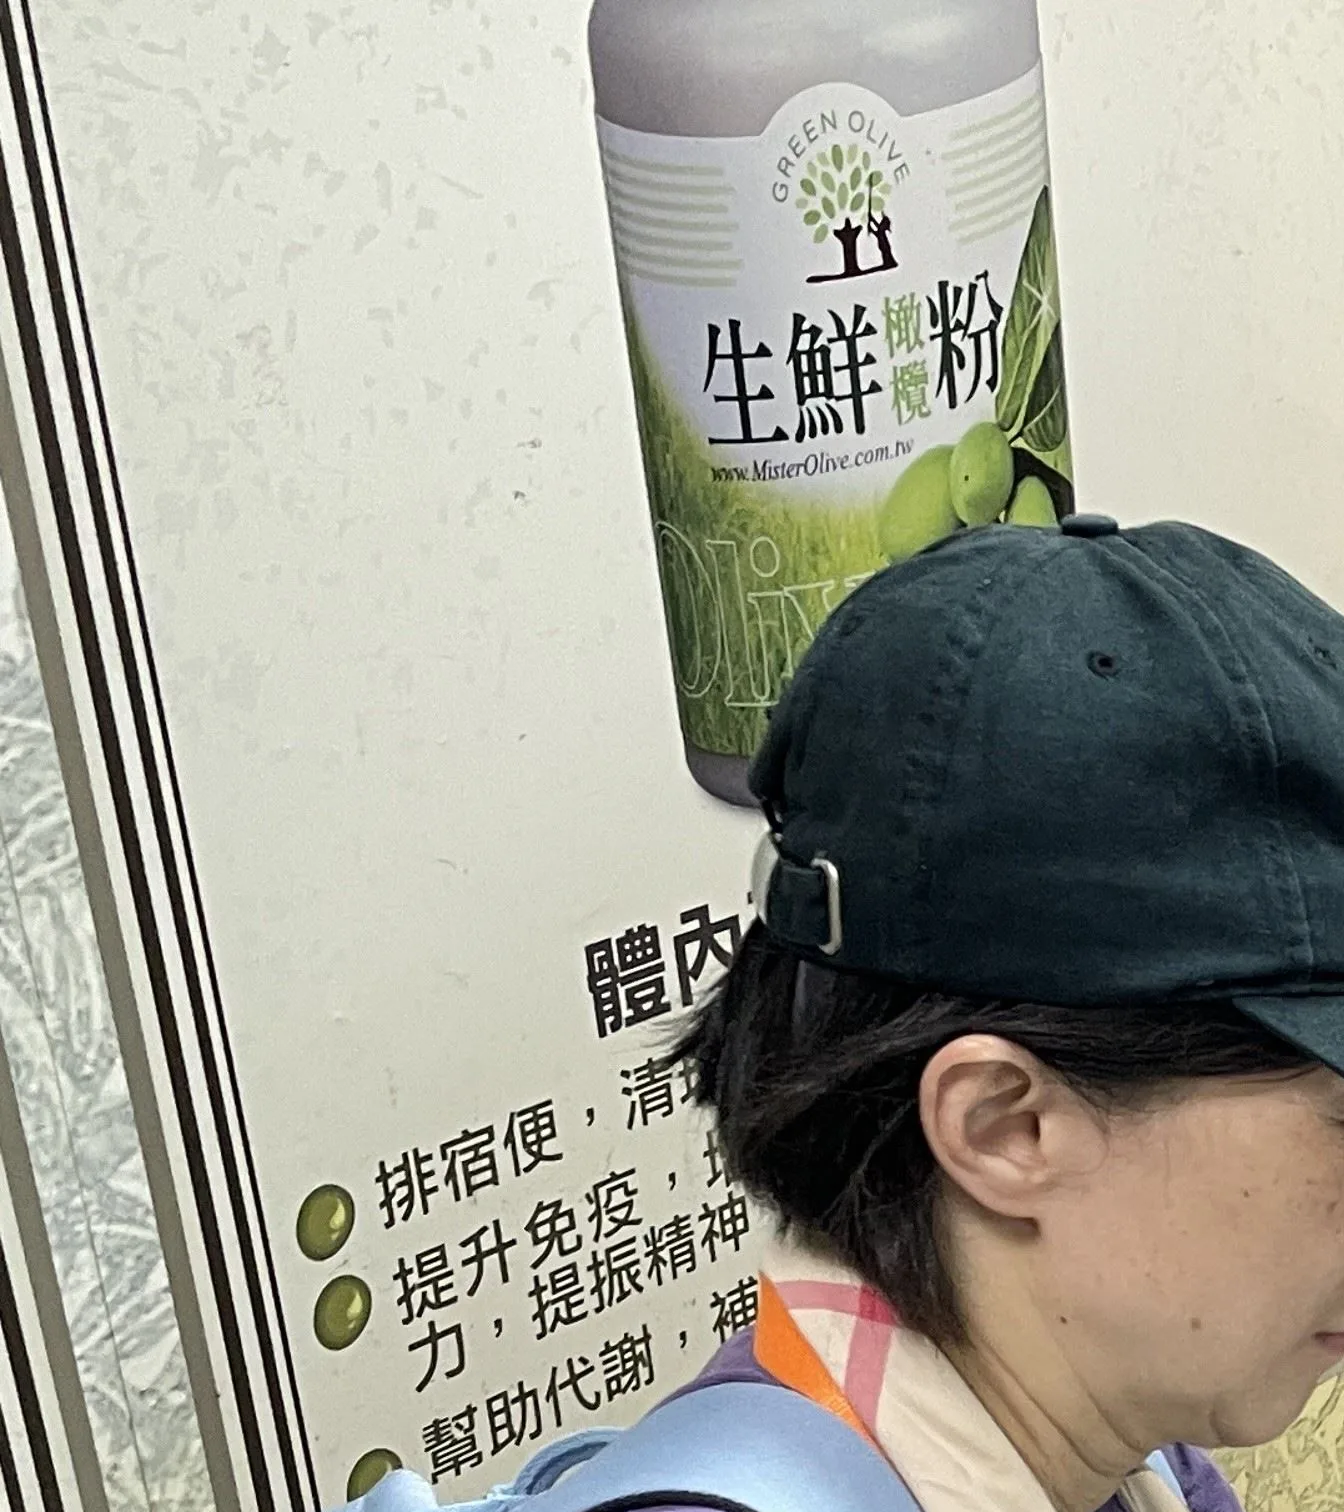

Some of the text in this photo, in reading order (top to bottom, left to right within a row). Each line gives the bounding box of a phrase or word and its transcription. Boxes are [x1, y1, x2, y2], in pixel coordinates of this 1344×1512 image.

[772, 110, 911, 203] GREEN OLIVE
[711, 438, 914, 483] www.MisterOlive.com.tw
[584, 891, 752, 1039] 體內
